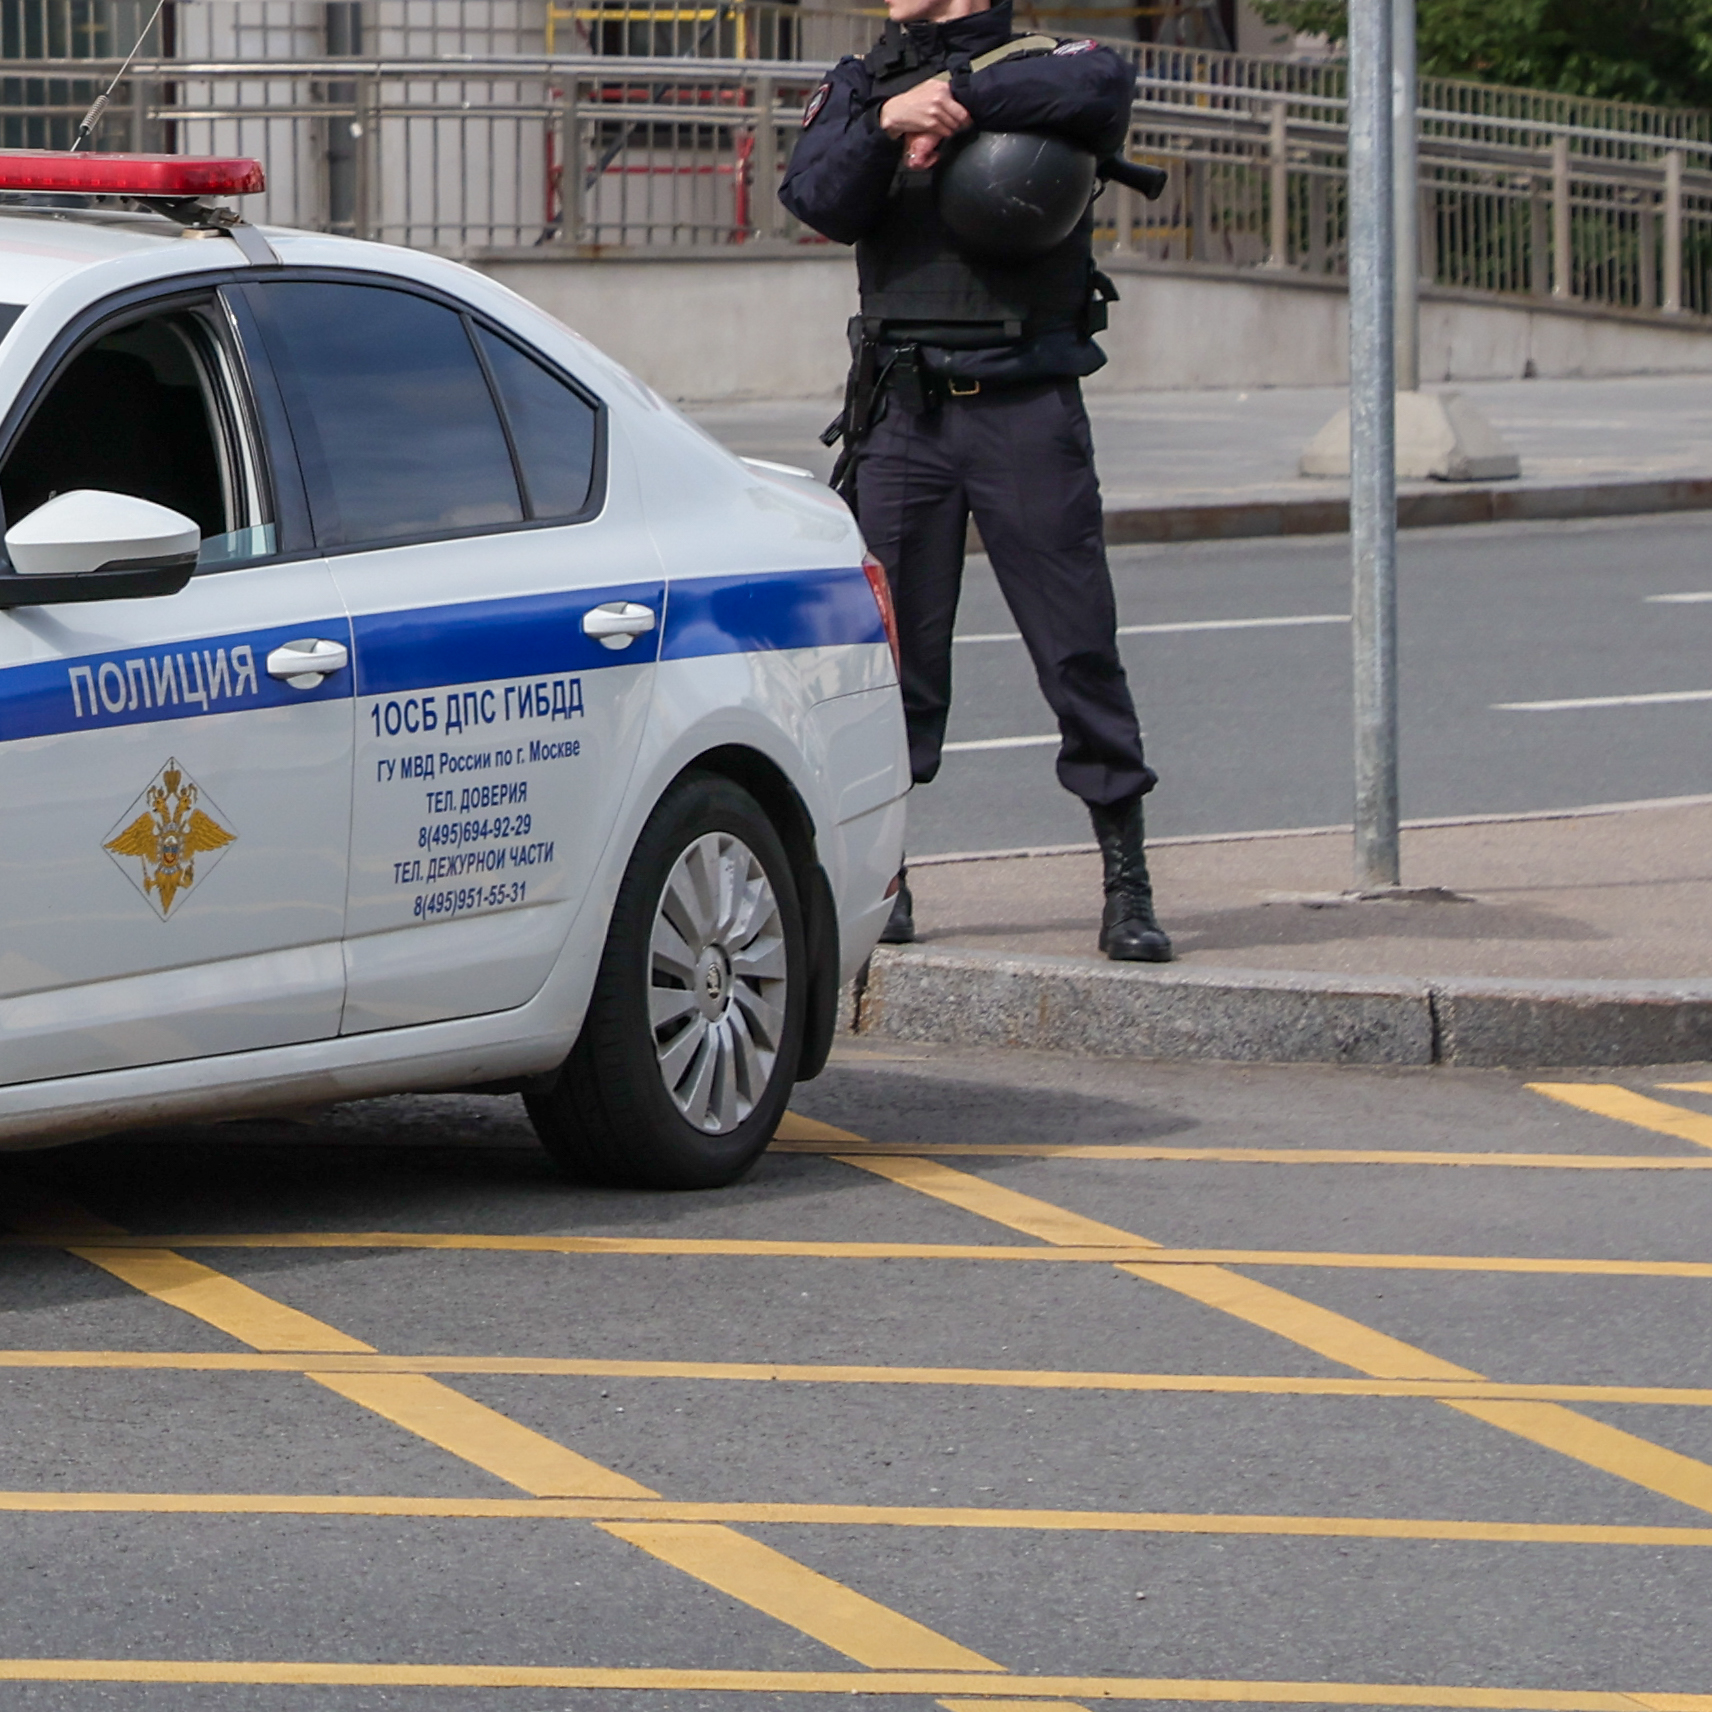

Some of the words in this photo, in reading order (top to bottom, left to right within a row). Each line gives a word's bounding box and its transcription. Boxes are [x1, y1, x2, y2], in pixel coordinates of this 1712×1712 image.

[67, 644, 258, 718] ПОЛИЦИЯ
[445, 688, 496, 735] ДПС
[504, 677, 584, 721] ГИБДД
[377, 758, 396, 782] ГУ
[400, 753, 435, 780] МВД
[439, 751, 491, 774] России
[495, 748, 512, 766] по
[517, 747, 525, 765] г.
[529, 739, 580, 762] Москве
[426, 790, 457, 814] ТЕЛ.
[459, 781, 528, 814] ДОВЕРИЯ
[418, 813, 532, 852] 8(495)694-92-29
[393, 860, 424, 885] ТЕЛ.
[509, 841, 555, 867] ЧАСТИ
[413, 880, 526, 920] 8(495)951-55-31
